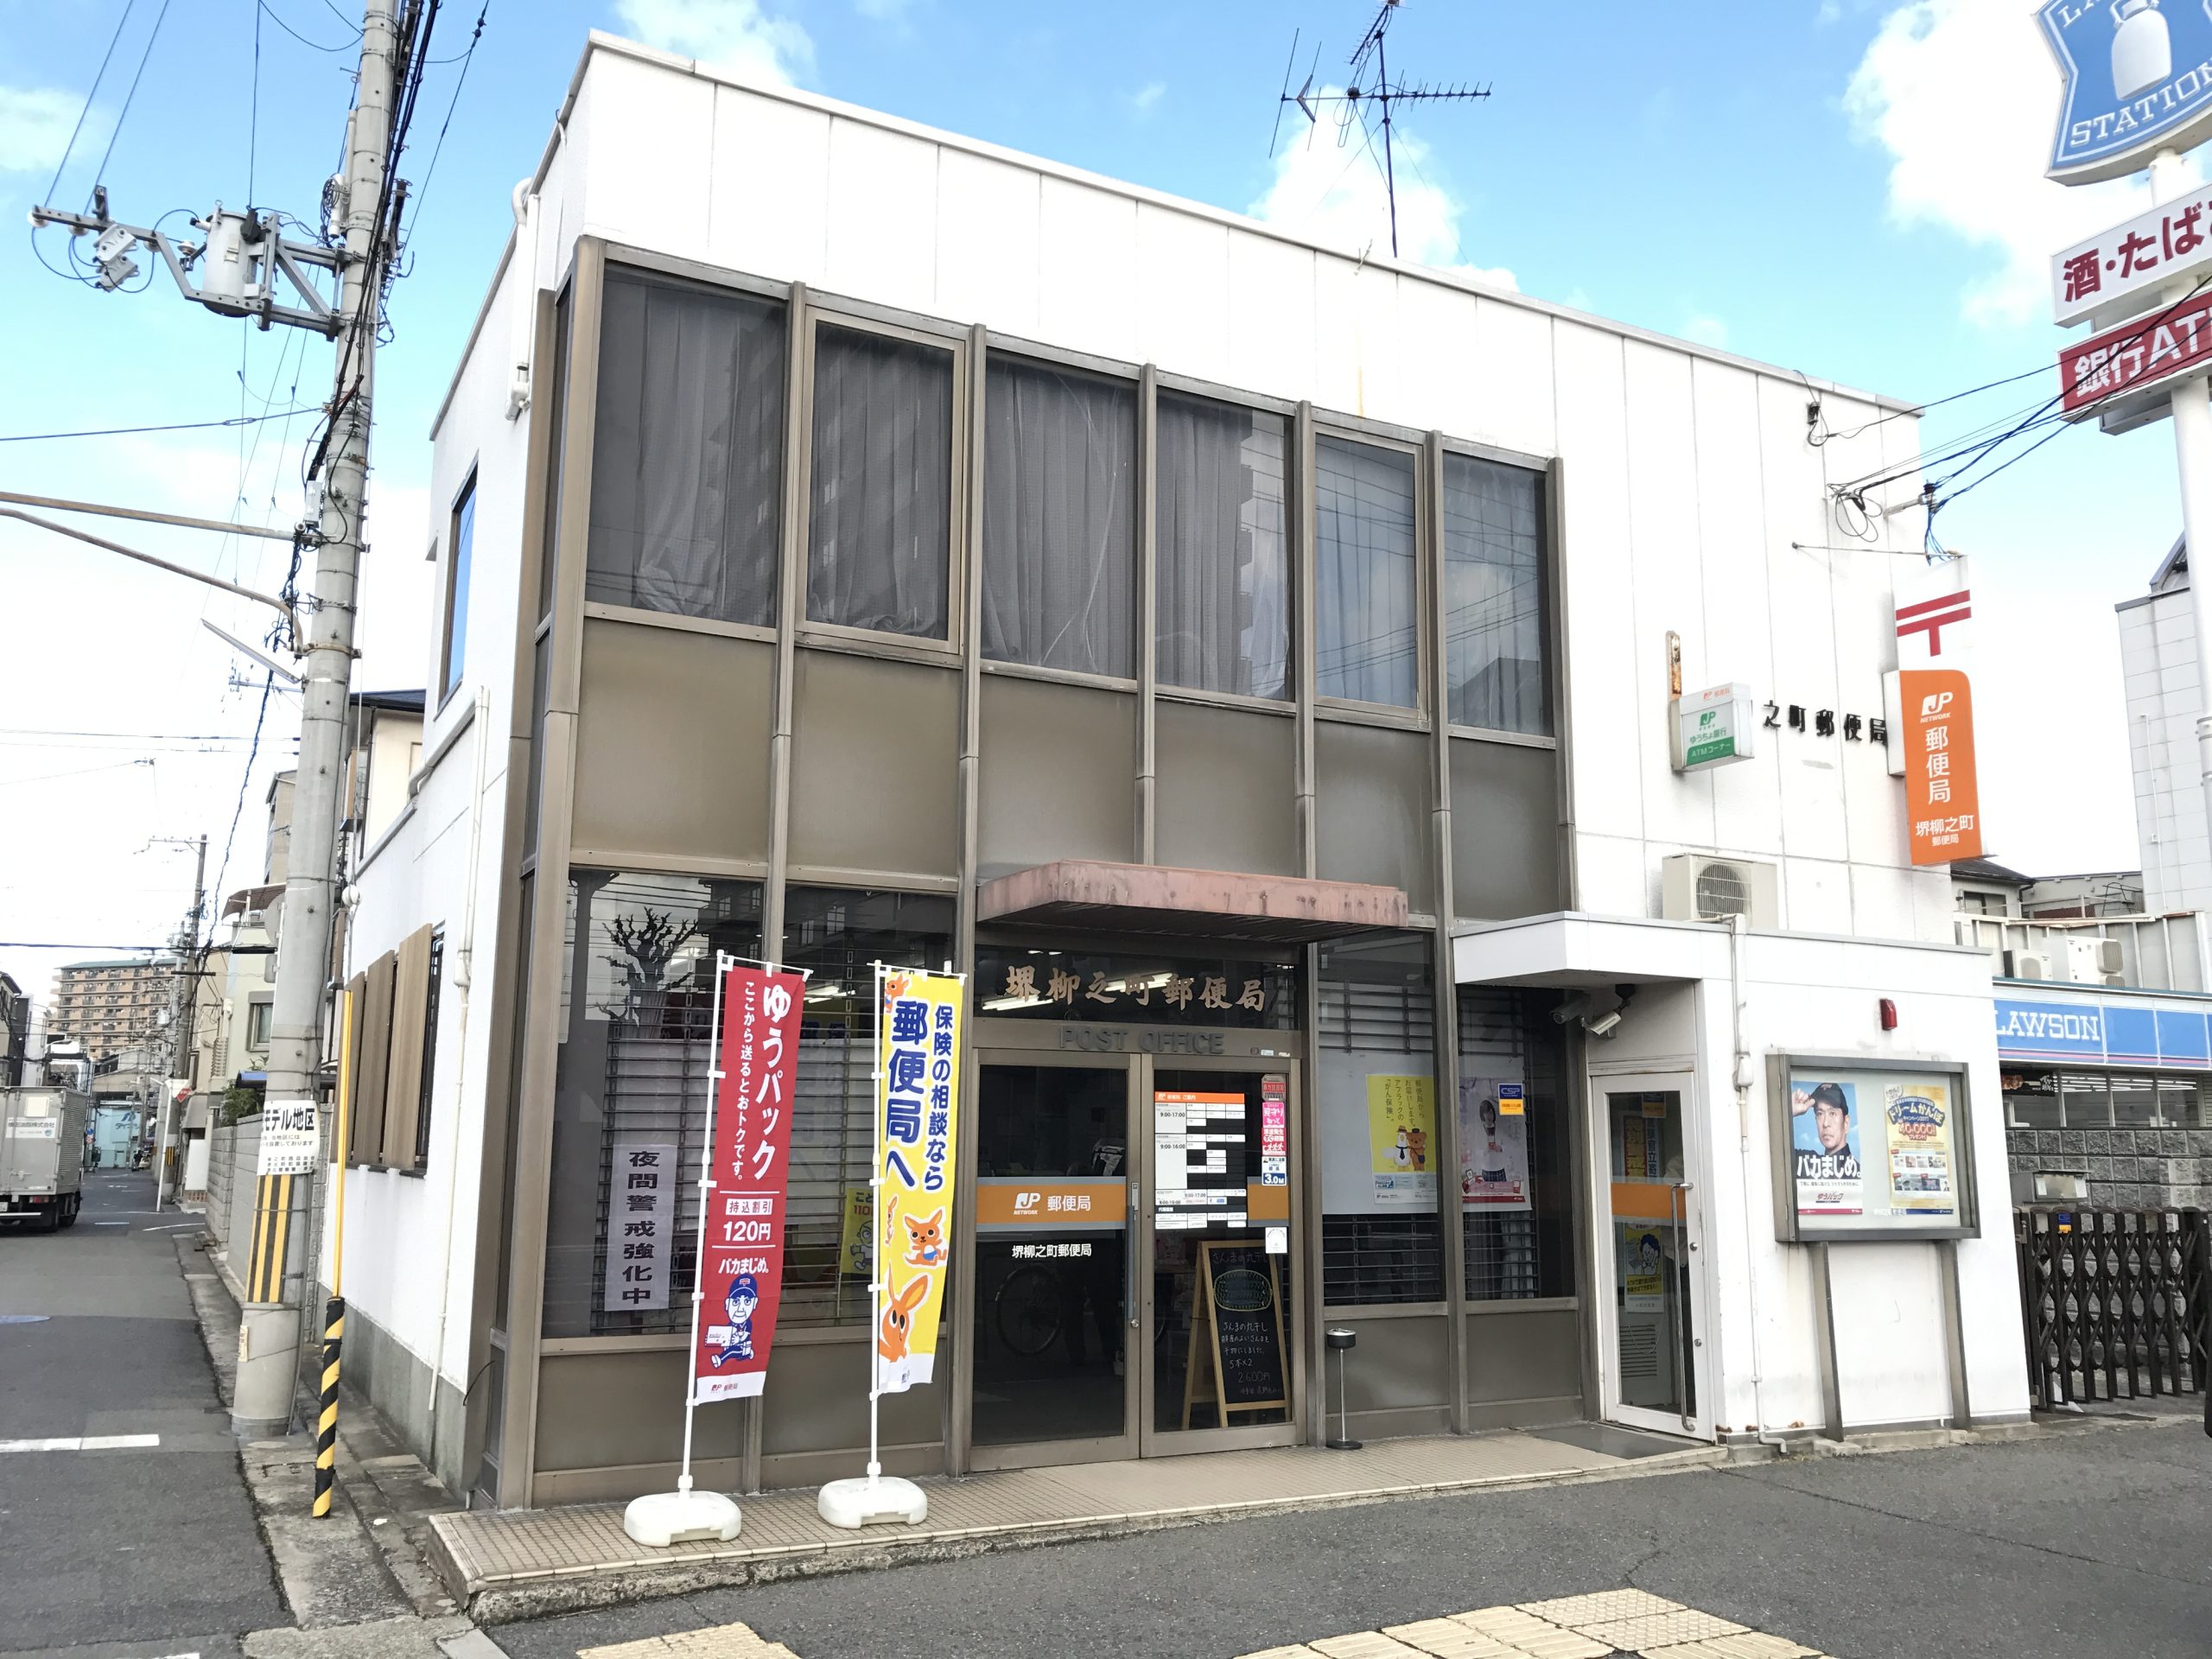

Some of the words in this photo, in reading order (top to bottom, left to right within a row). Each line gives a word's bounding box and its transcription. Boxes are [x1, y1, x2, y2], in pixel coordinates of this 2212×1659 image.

[2063, 200, 2212, 302] 酒・たば
[2074, 308, 2212, 398] 銀行AT
[1920, 712, 1951, 724] NETWORK
[1925, 726, 1951, 805] 郵便局
[1915, 815, 1974, 837] 堺柳之町
[1931, 833, 1960, 847] 郵便局
[1005, 965, 1267, 1012] 堺柳之町郵便局
[1058, 1026, 1128, 1051] POST
[1139, 1029, 1225, 1054] OFFICE
[732, 982, 755, 1180] ここから送るとおトクです。
[752, 984, 791, 1180] ゆうパック
[886, 1001, 929, 1188] 郵便局へ
[925, 1005, 953, 1191] 保険の相談なら
[1395, 1079, 1404, 1121] アフラックの
[1797, 1154, 1861, 1179] バカまじめ。
[729, 1200, 772, 1213] 持込割引
[1047, 1195, 1091, 1211] 郵便局
[621, 1151, 660, 1305] 夜間警戒強化中
[723, 1220, 772, 1242] 120円
[1012, 1243, 1092, 1259] 堺柳之町郵便局
[718, 1257, 769, 1275] バカまじめ。
[1223, 1321, 1268, 1332] さんまの丸干し
